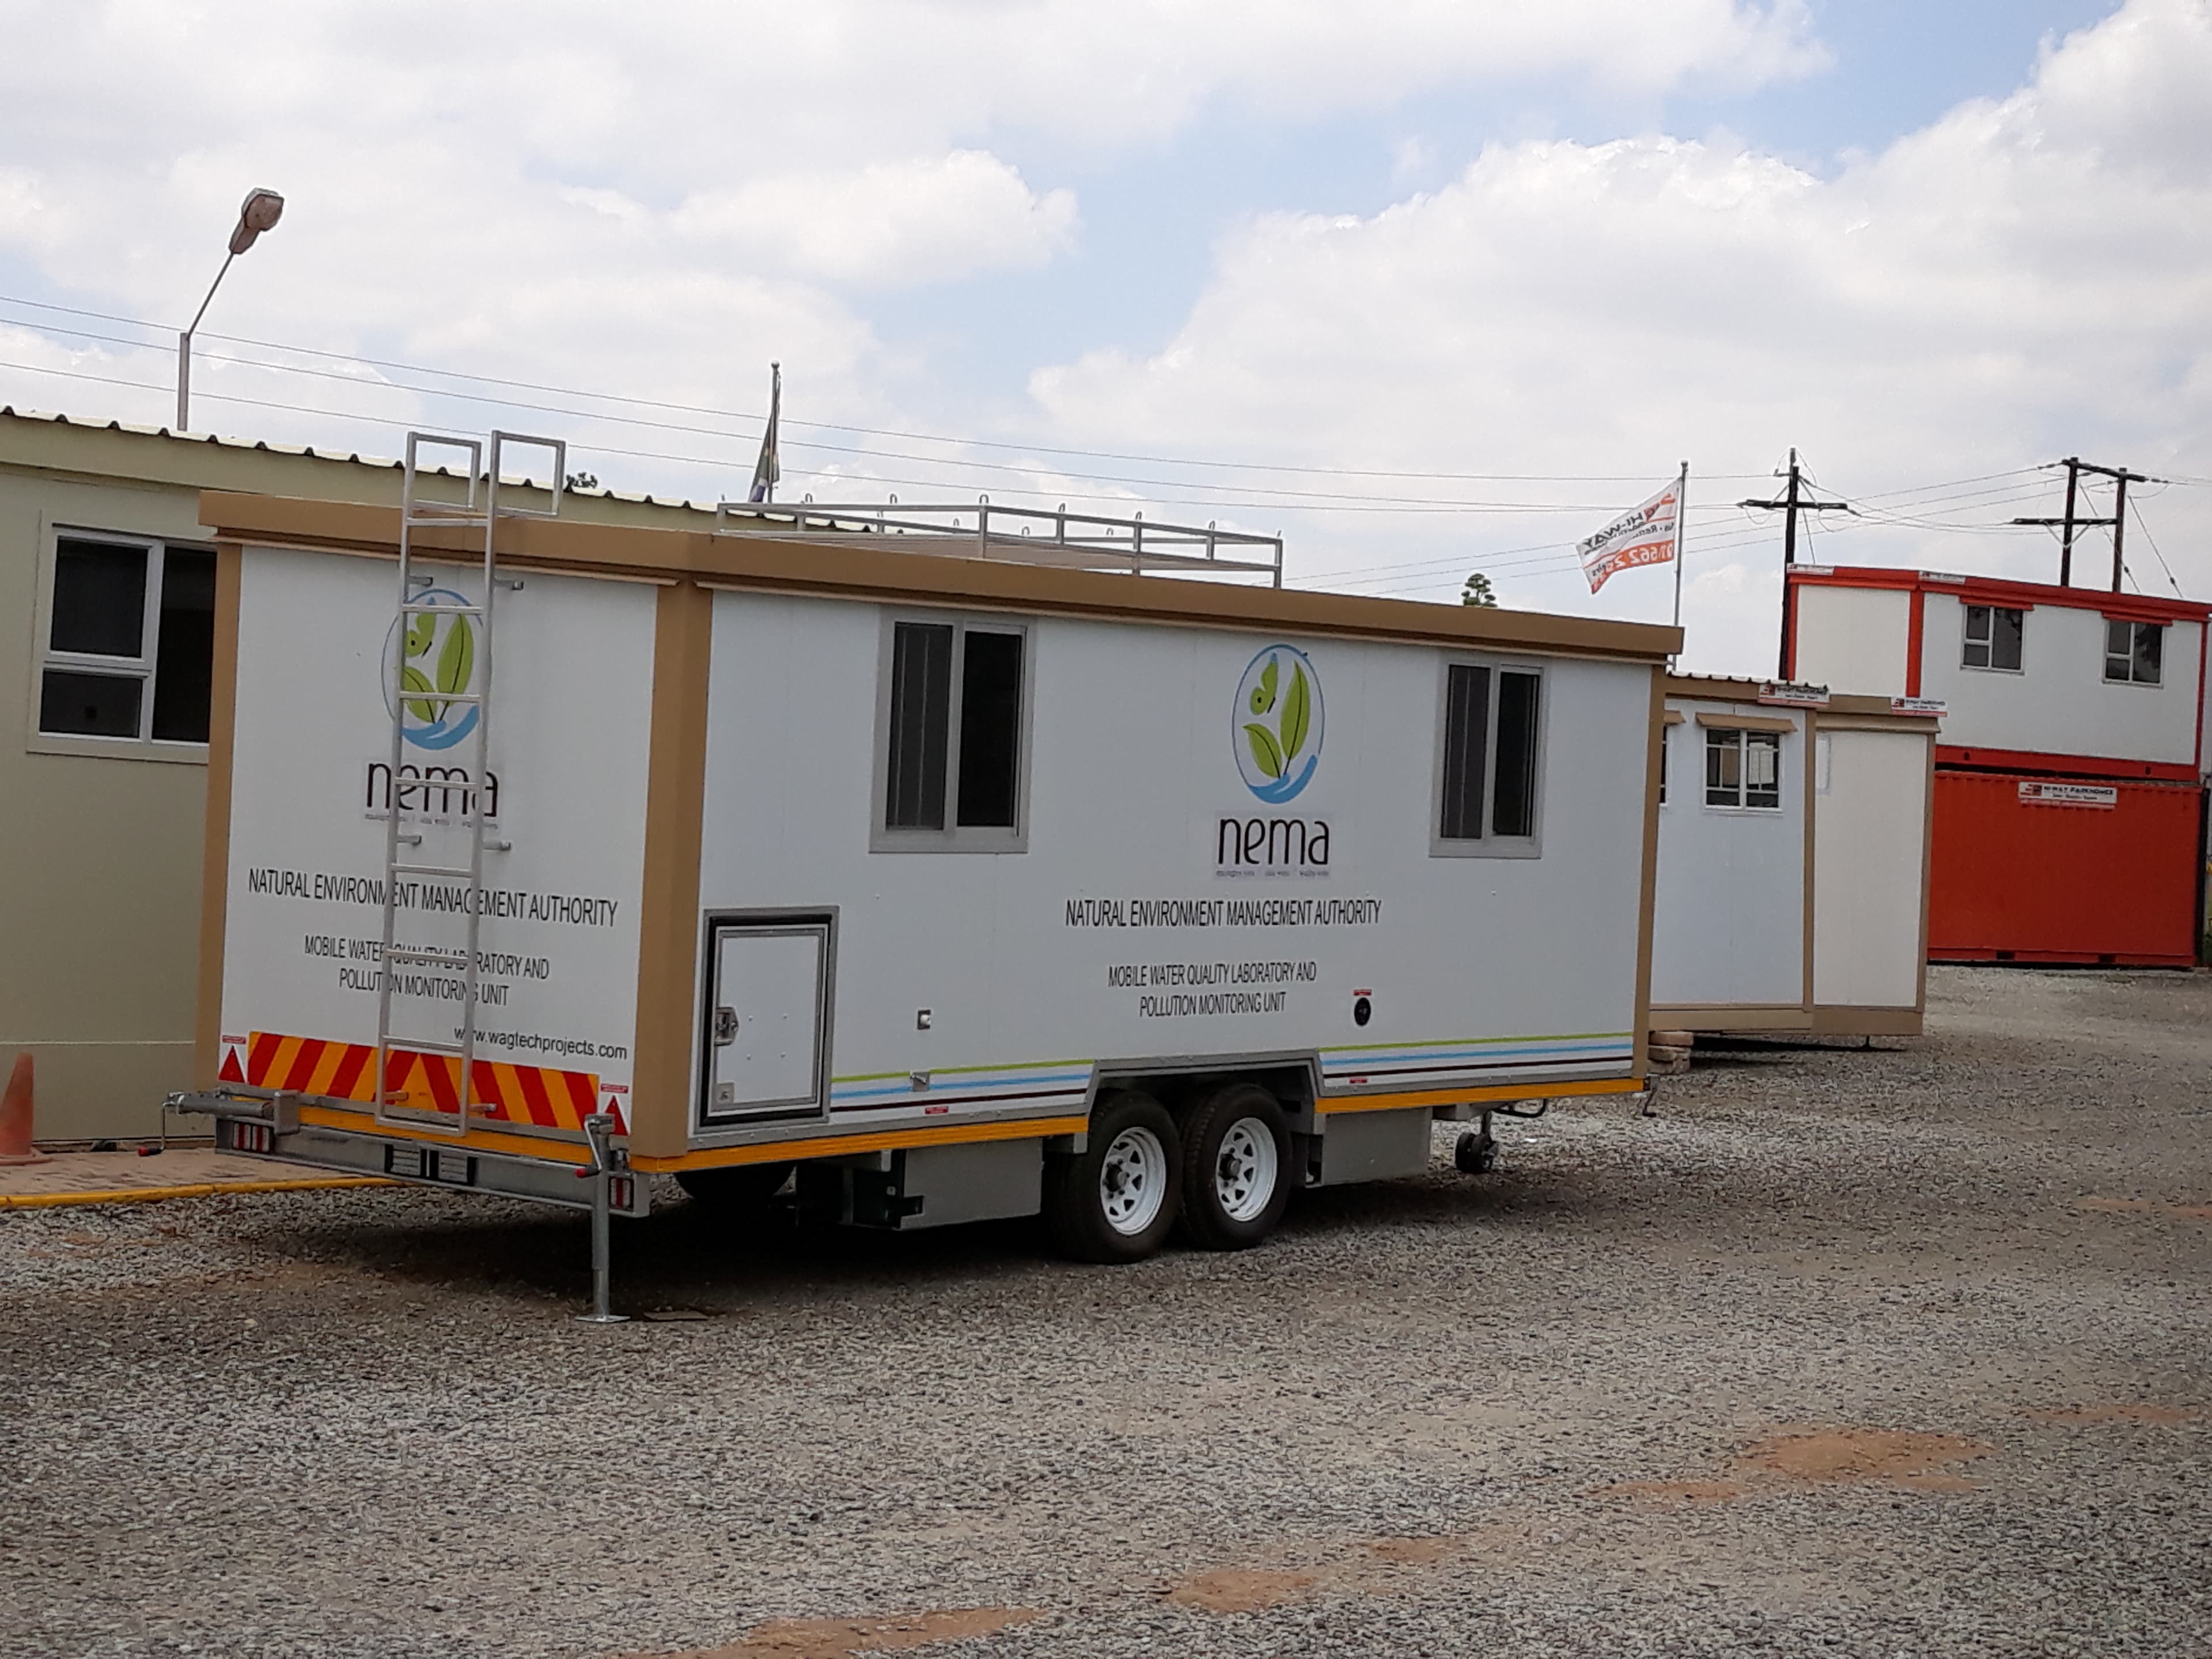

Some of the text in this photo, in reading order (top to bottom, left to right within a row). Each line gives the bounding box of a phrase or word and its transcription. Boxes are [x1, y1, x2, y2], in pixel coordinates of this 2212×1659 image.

[1218, 818, 1330, 865] nema
[249, 868, 310, 898] NATURAL
[528, 894, 619, 927] AUTHORITY
[1066, 900, 1382, 927] NATURAL ENVIRONMENT MANAGEMENT AUTHORITY
[305, 935, 346, 959] MOBILE
[444, 948, 524, 976] LABRATORY
[524, 957, 549, 980] AND
[1108, 961, 1317, 987] MOBILE WATER QUALITY LABORATORY AND
[339, 968, 402, 994] POLLUTN
[482, 983, 509, 1006] UNIT
[1139, 991, 1287, 1017] POLLUTION MONITORING UNIT
[454, 1027, 627, 1060] ww.wagtechprojects.com
